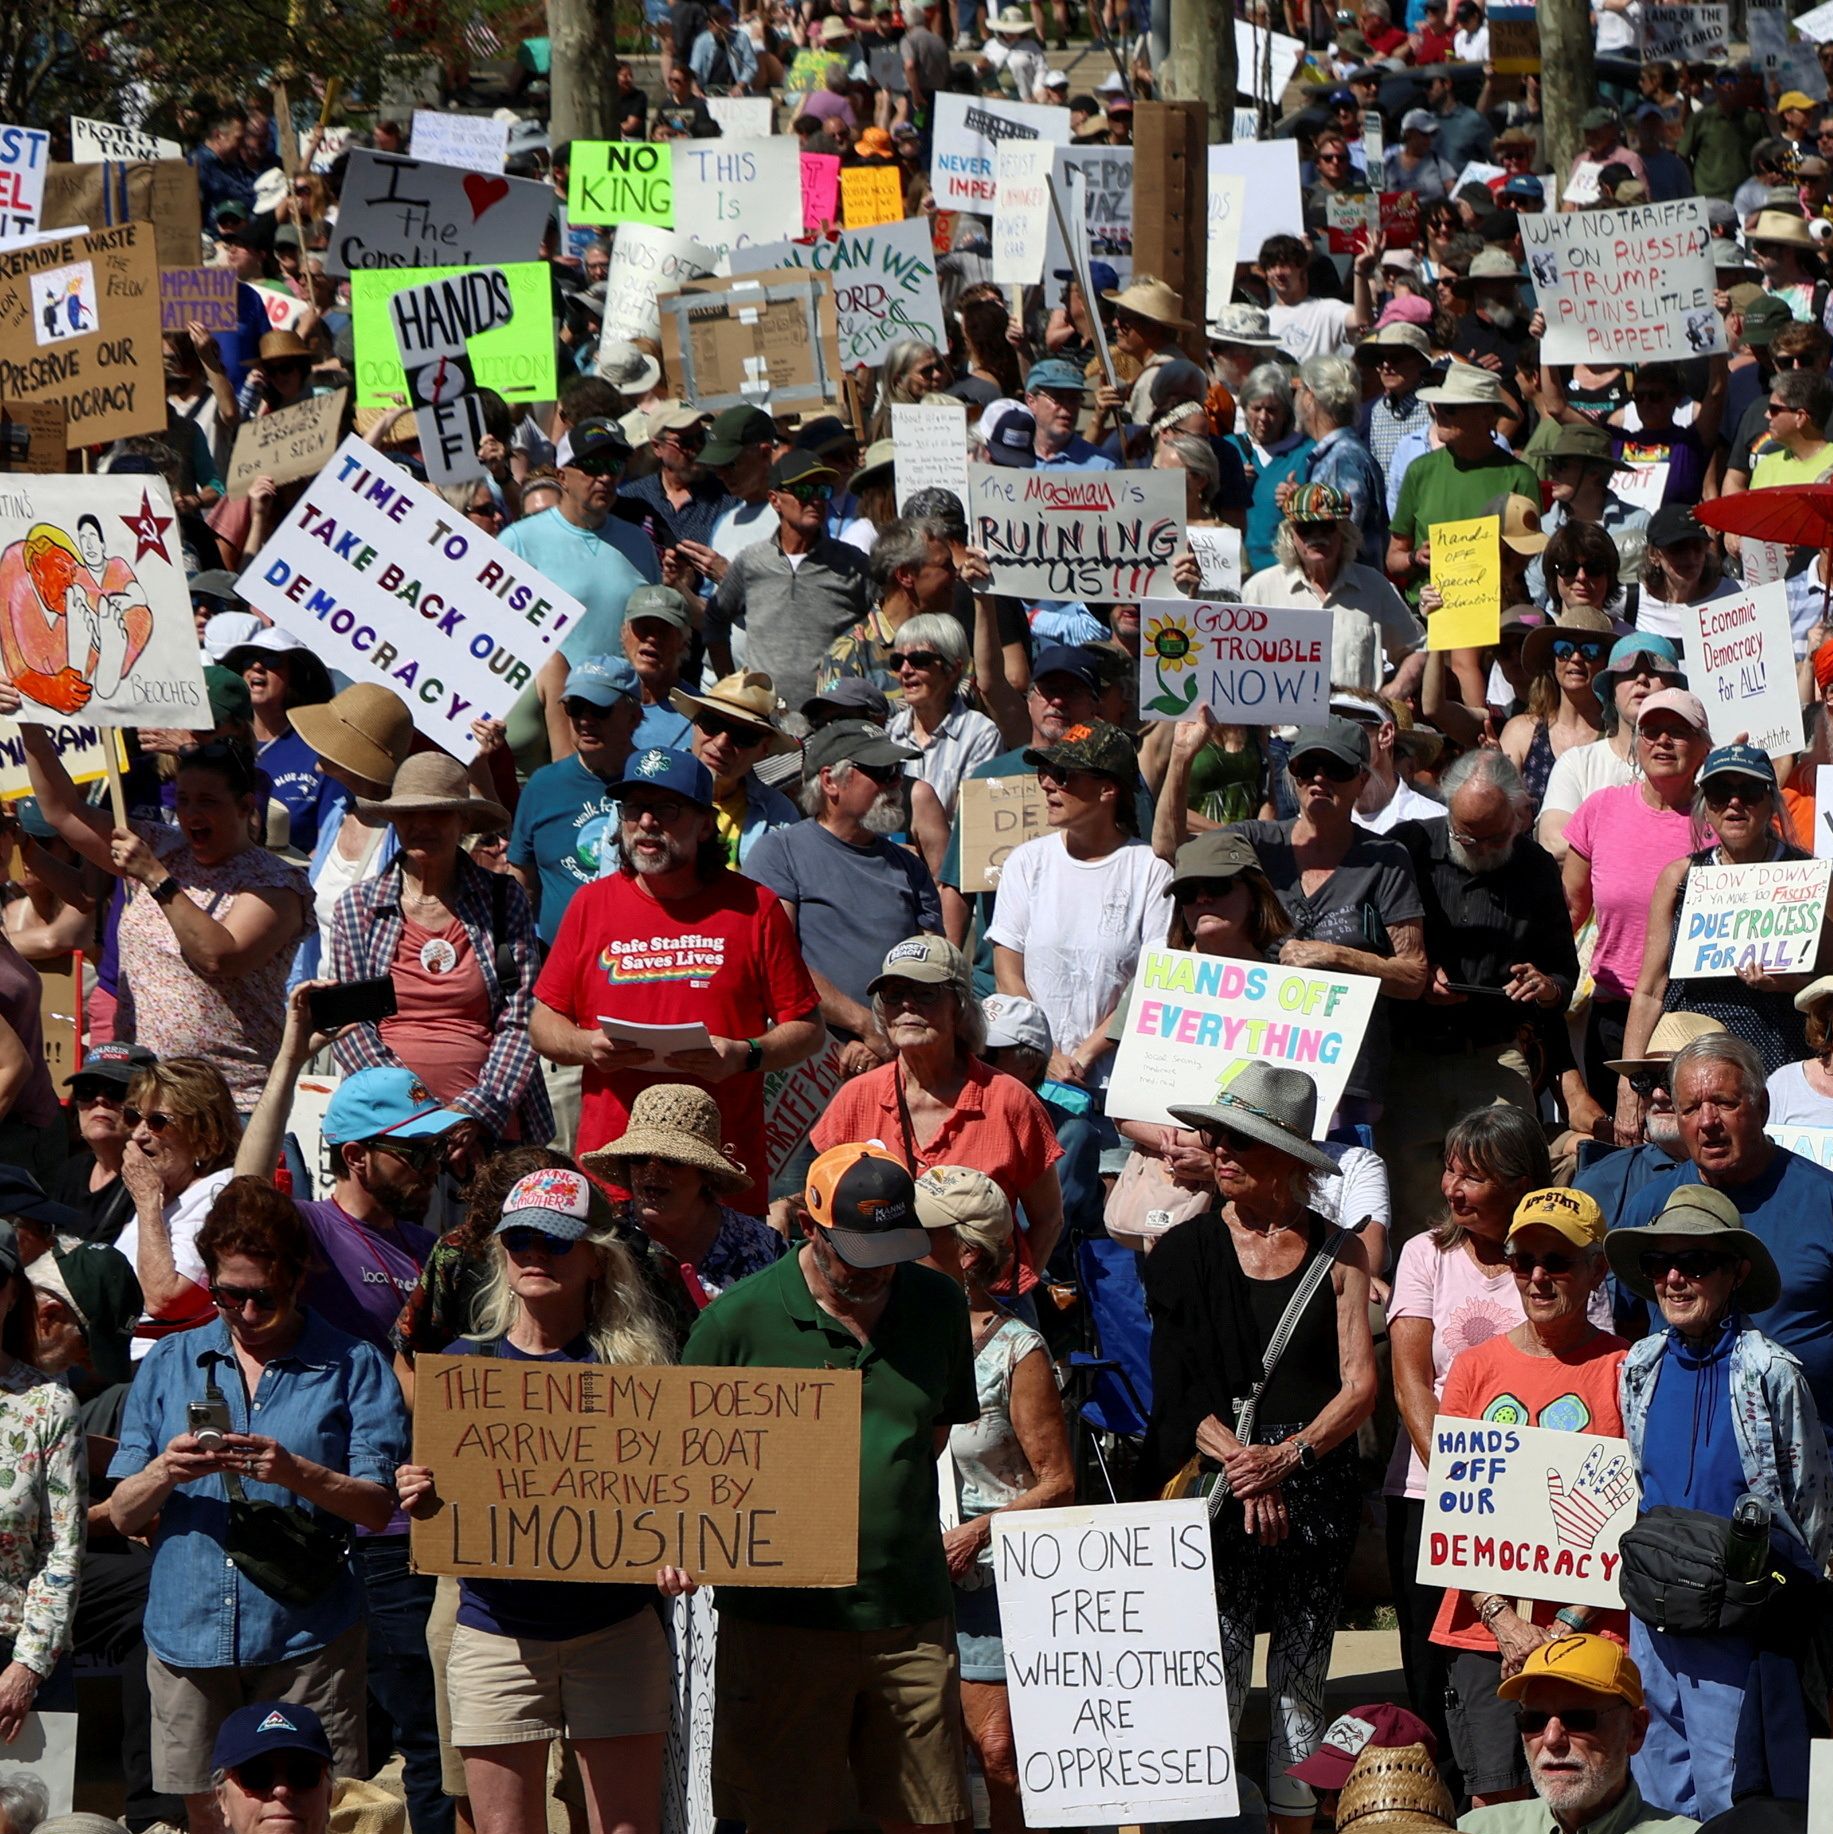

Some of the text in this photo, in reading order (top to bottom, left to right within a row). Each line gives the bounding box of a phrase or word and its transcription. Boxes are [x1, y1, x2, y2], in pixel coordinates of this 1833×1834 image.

[608, 146, 658, 172] NO
[582, 177, 671, 213] KING
[1525, 202, 1699, 245] WHY NO TARIFFS
[1568, 226, 1710, 267] ON RUSSIA?
[1564, 267, 1667, 296] TRUMP:
[1558, 288, 1708, 324] PUTIN'S LITTLE
[1588, 325, 1671, 352] PUPPET!
[981, 475, 1144, 504] The Madman is
[335, 455, 568, 643] TIME TO RISE!
[1194, 606, 1267, 633] GOOD
[1698, 598, 1757, 638] Economic
[1211, 637, 1322, 663] TROUBLE
[1704, 631, 1762, 672] Democracy
[1211, 669, 1320, 706] NOW!
[1689, 905, 1821, 938] DUE PROCESS
[610, 935, 726, 957] Safe Staffing
[623, 951, 725, 971] Saves Lives
[1695, 940, 1811, 971] FOR ALL!
[1144, 952, 1349, 1018] HANDS OFF
[1137, 1001, 1342, 1065] EVERYTHING
[435, 1365, 834, 1421] THE ENEMY DOESN'T
[455, 1423, 768, 1470] ARRIVE BY BOAT
[1438, 1429, 1521, 1454] HANDS
[1446, 1458, 1506, 1485] OFF
[1440, 1488, 1495, 1515] OUR
[453, 1504, 783, 1571] LIMOUSINE
[1004, 1524, 1206, 1580] NO ONE IS
[1430, 1533, 1619, 1582] DEMOCRACY
[1052, 1590, 1143, 1636] FREE
[1011, 1649, 1222, 1691] WHEN OTHERS
[1073, 1699, 1134, 1734] ARE
[1025, 1744, 1230, 1792] OPPRESSED
